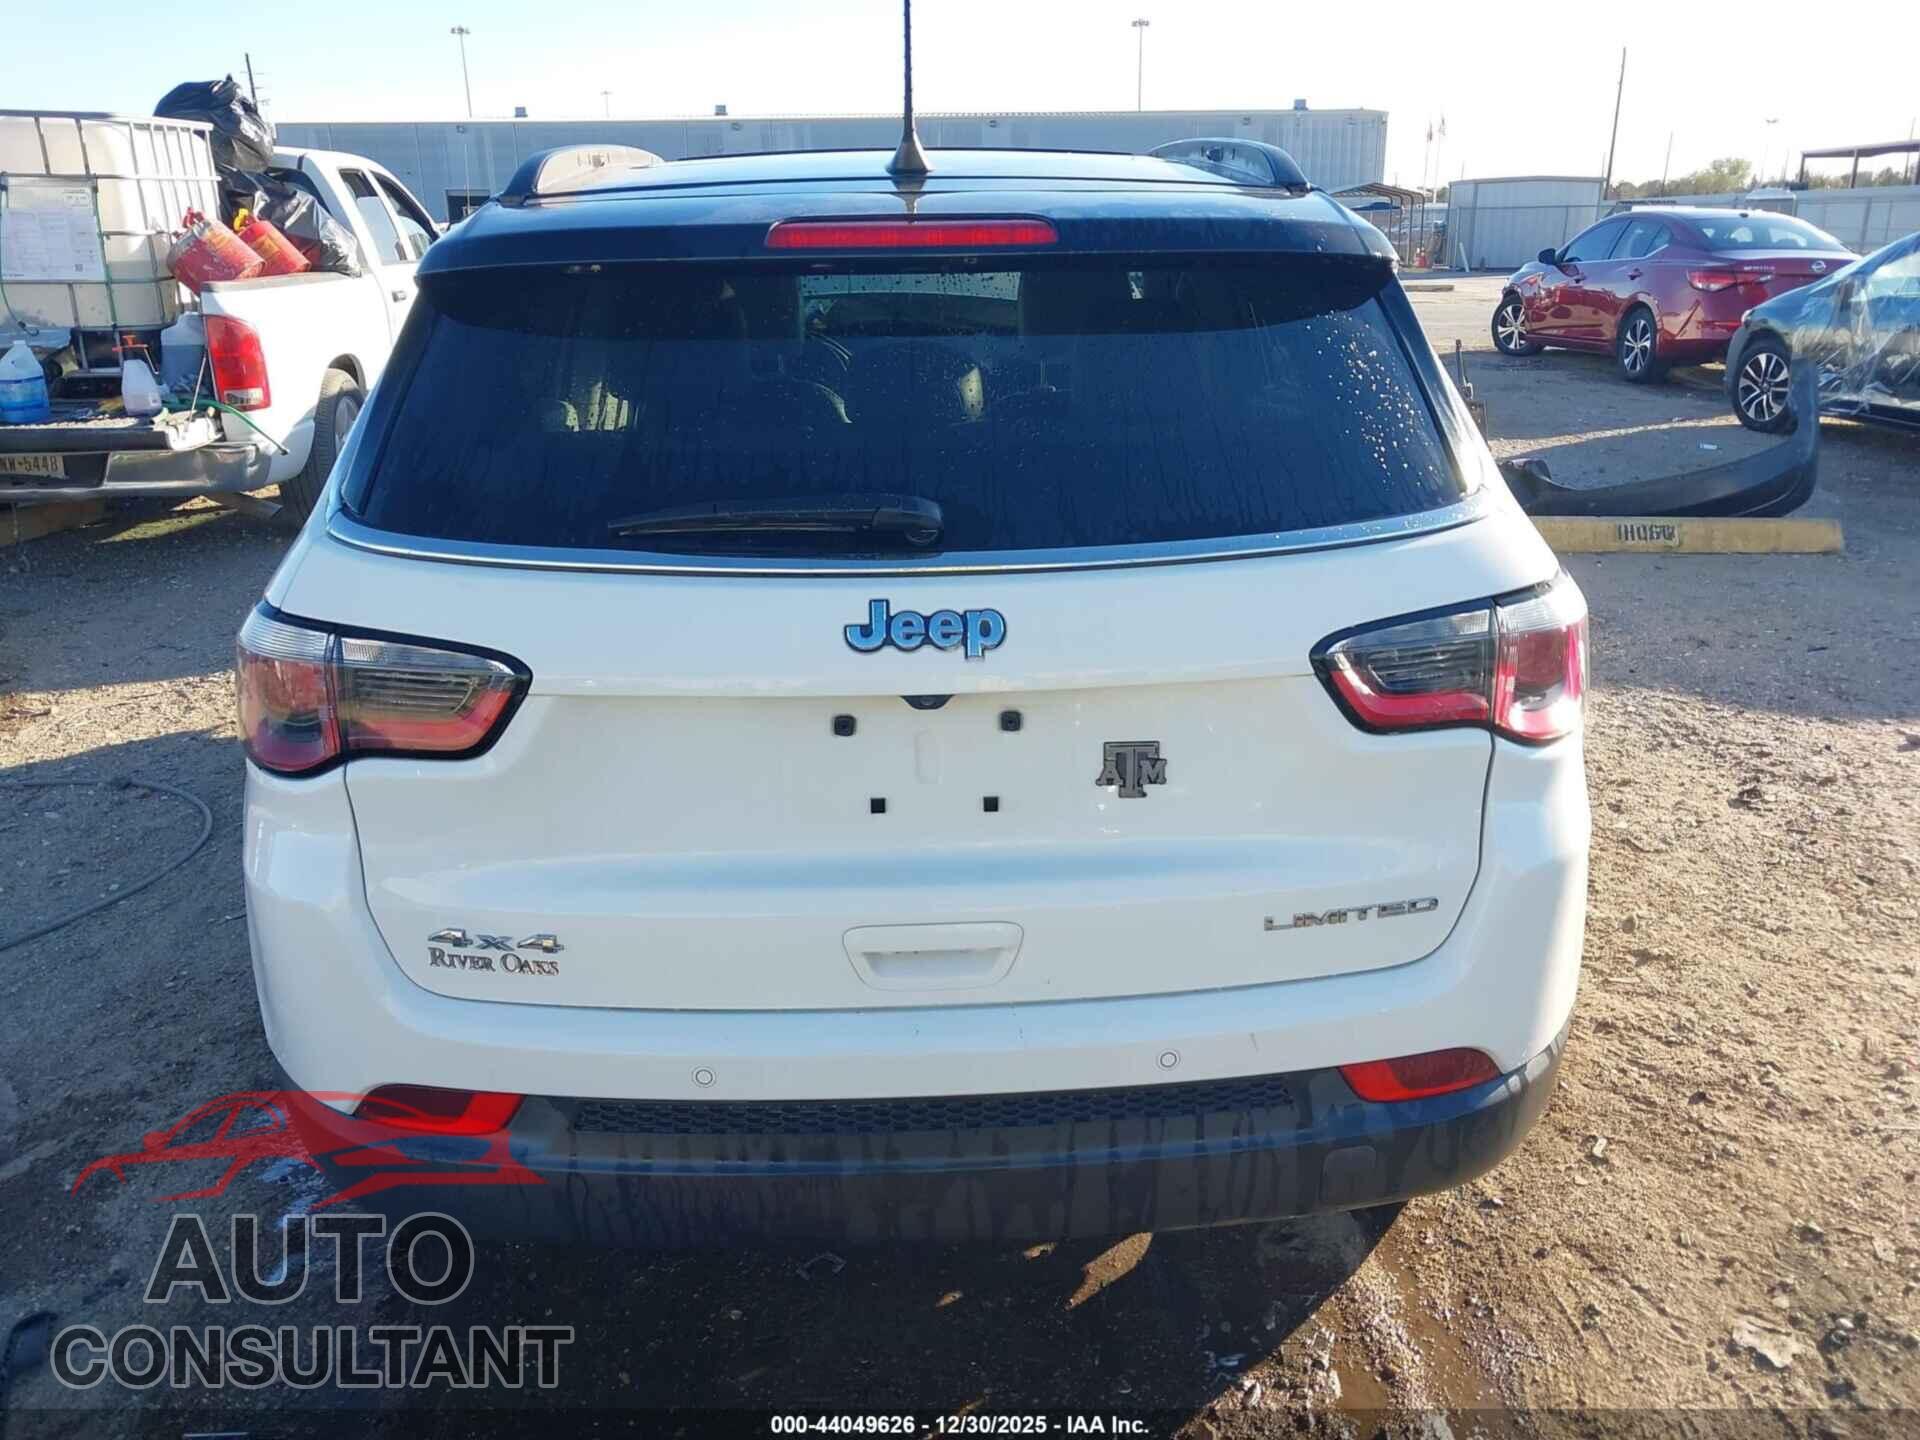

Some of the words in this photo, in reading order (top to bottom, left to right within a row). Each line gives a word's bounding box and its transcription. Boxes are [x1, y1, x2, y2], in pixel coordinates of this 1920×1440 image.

[844, 599, 1006, 659] Jeep
[1263, 897, 1439, 931] LIMITED
[428, 928, 565, 954] 4x4
